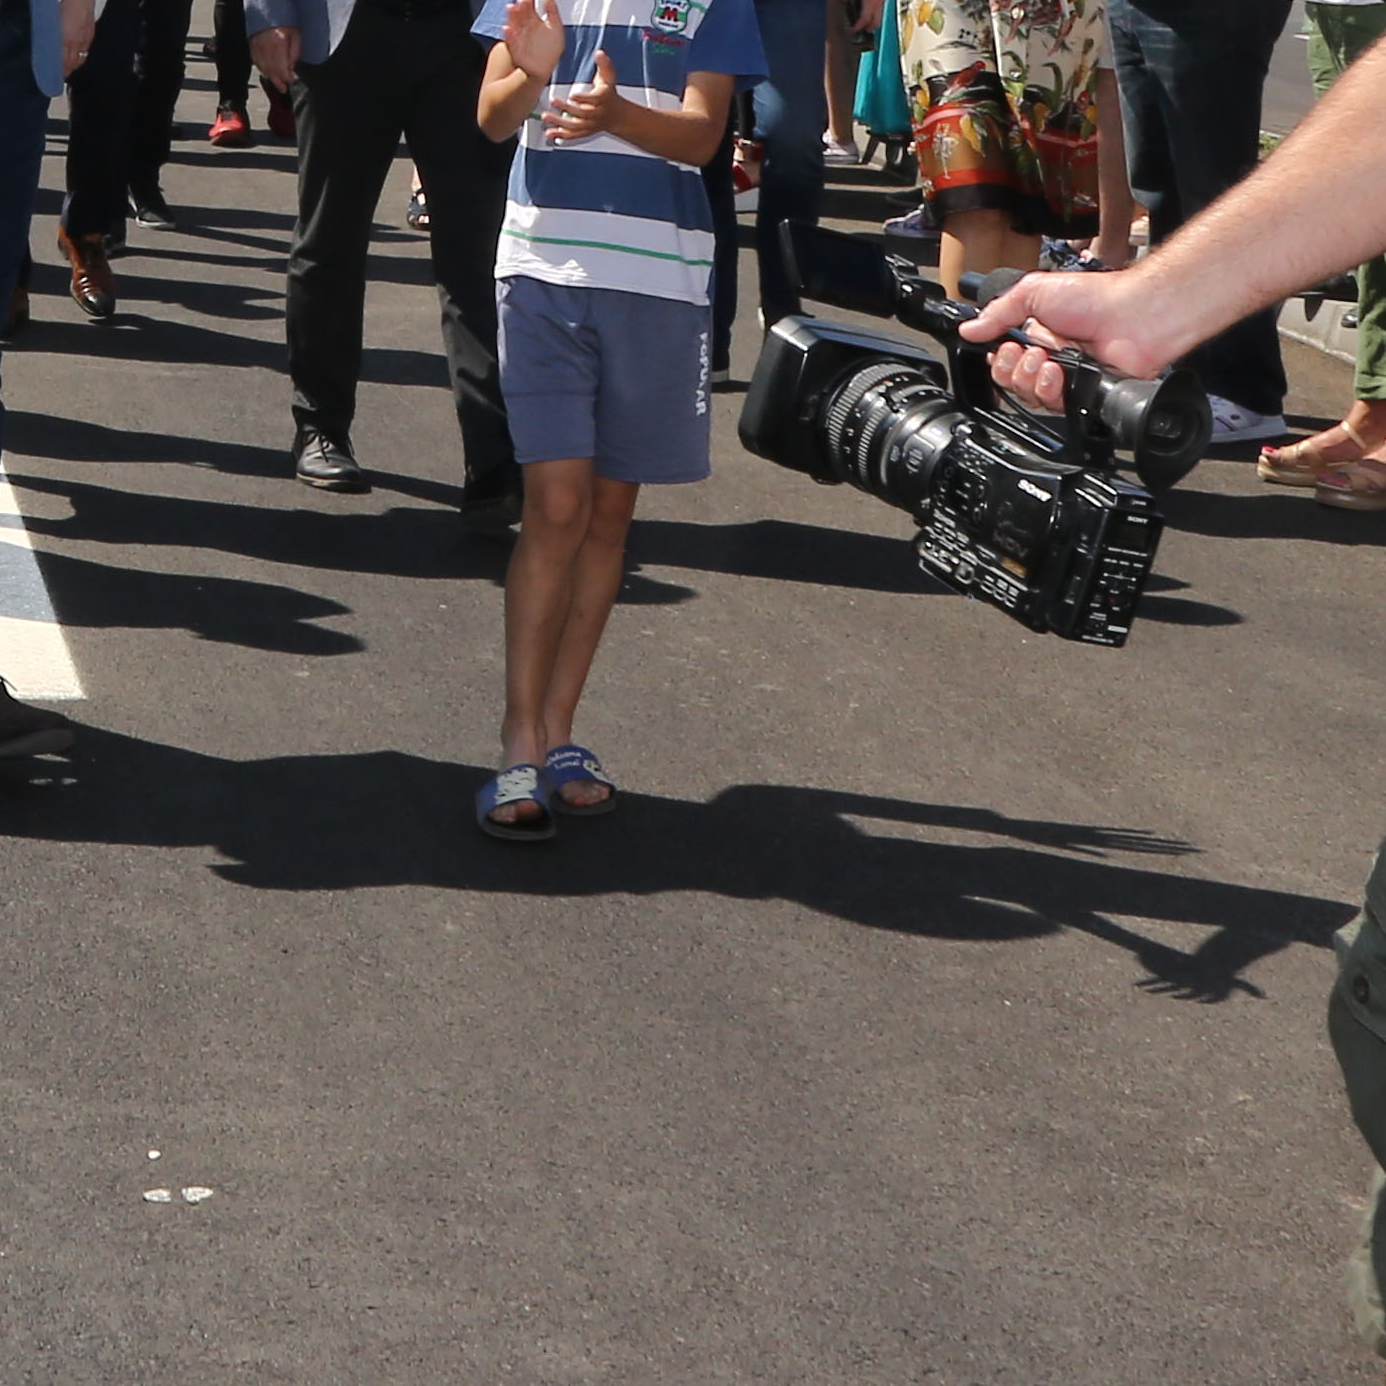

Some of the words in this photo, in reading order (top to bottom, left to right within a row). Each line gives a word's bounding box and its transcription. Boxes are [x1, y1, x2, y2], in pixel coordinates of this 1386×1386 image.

[695, 332, 709, 416] POPULAR
[1017, 479, 1052, 502] SONY
[1127, 515, 1149, 524] SONY
